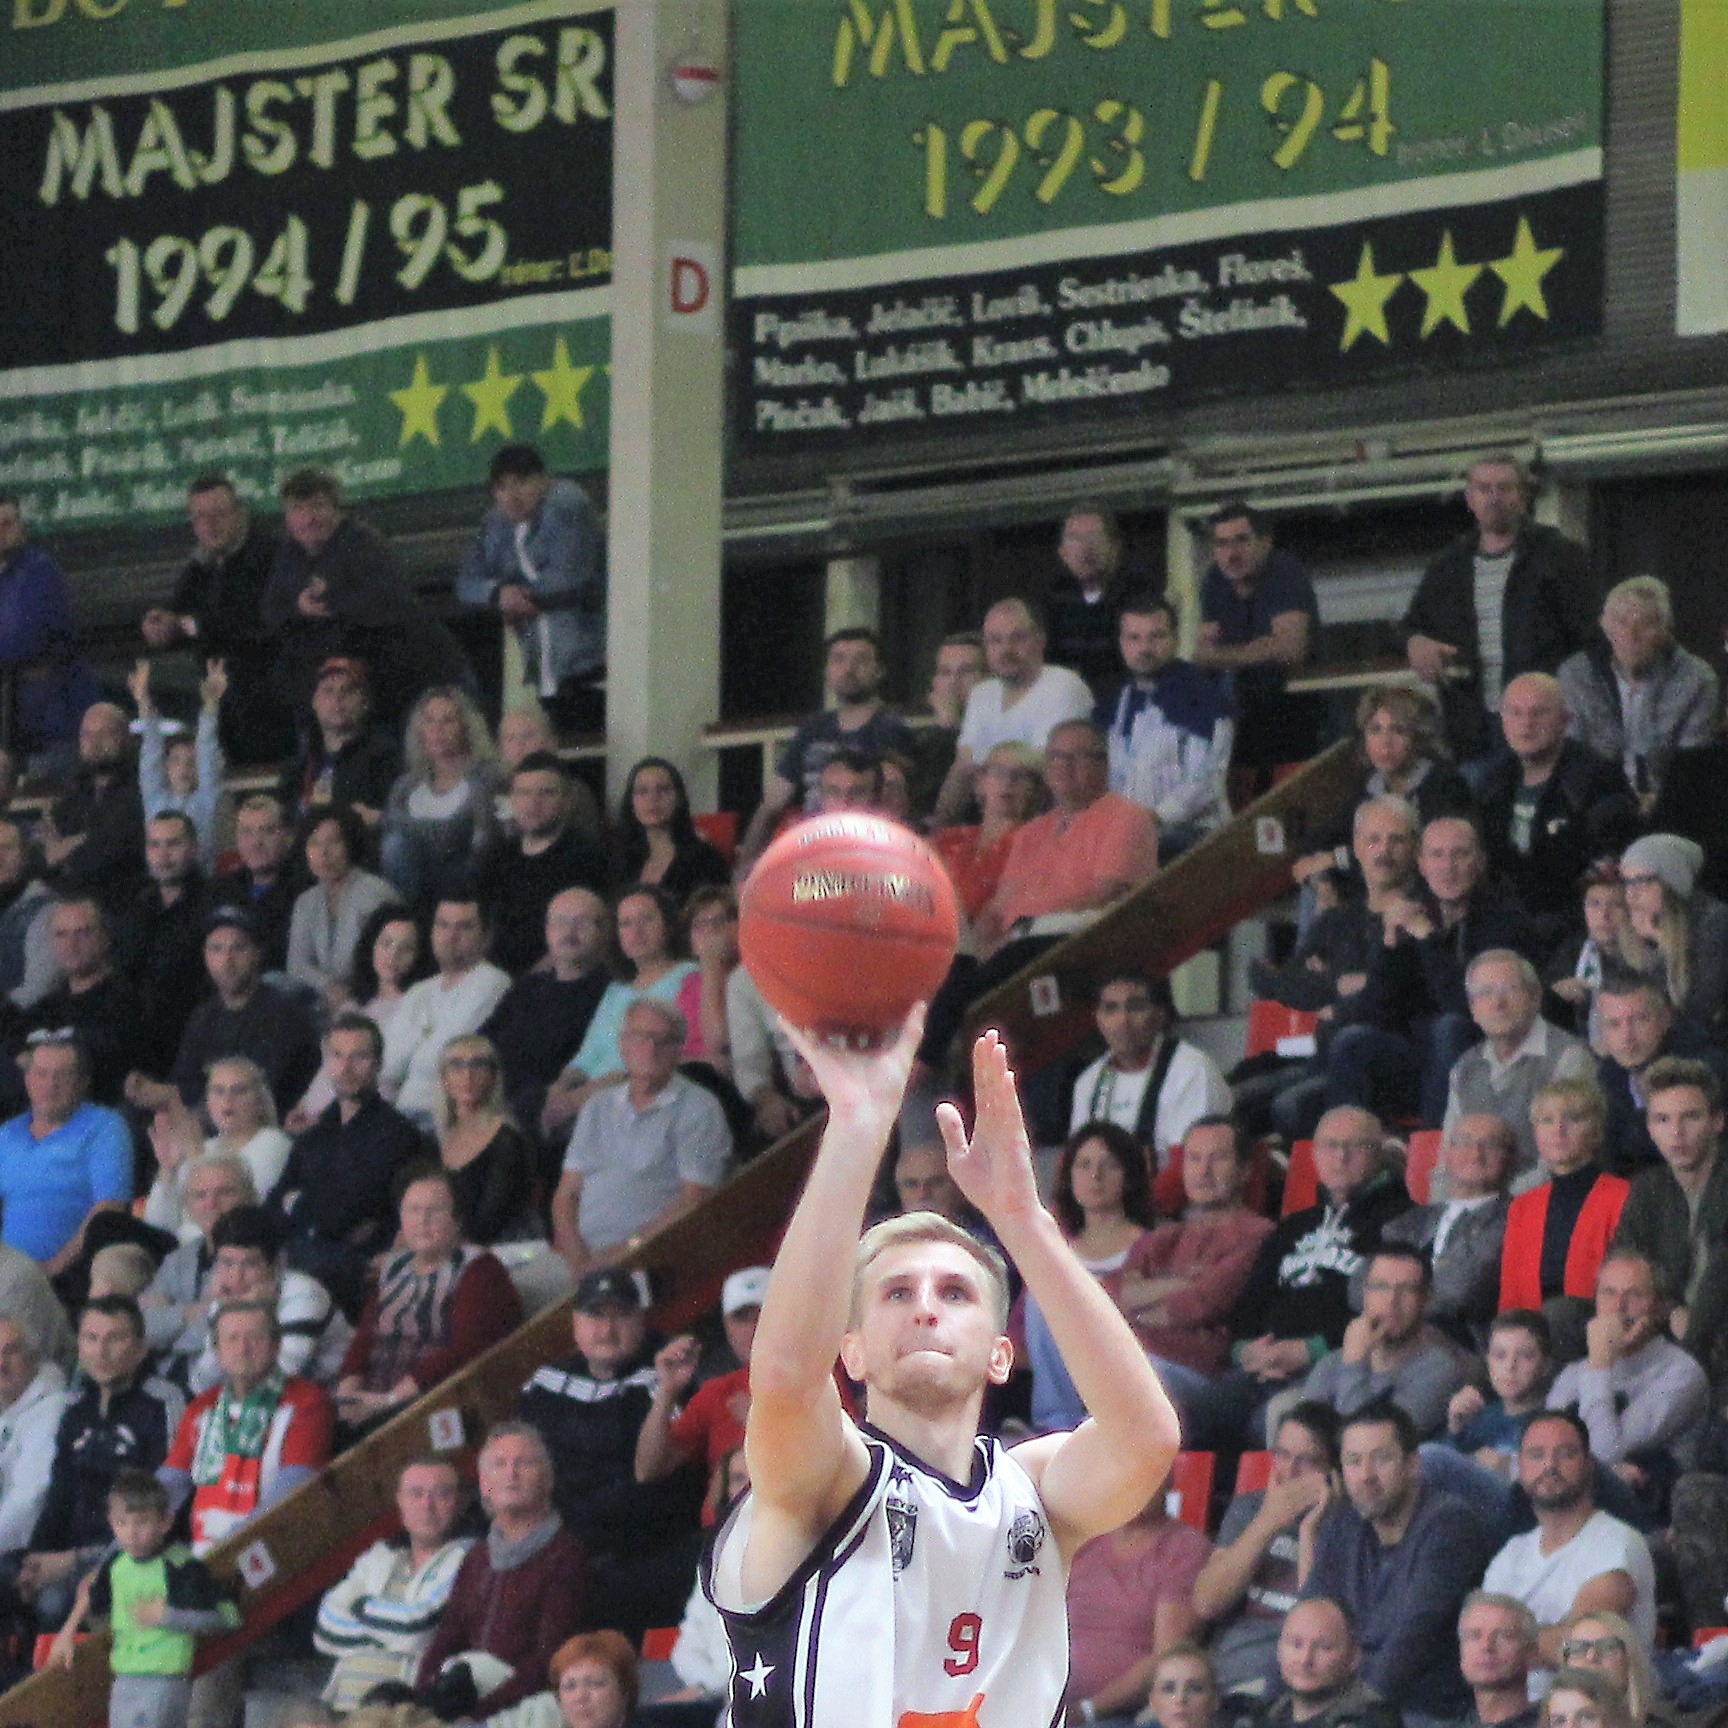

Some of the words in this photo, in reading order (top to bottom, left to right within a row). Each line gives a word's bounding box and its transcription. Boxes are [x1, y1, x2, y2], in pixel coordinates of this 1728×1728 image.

[38, 53, 461, 207] MAJSTER
[491, 26, 611, 132] SR
[912, 99, 1145, 218] 1993
[1260, 57, 1396, 169] 94
[106, 213, 314, 335] 1994
[390, 180, 508, 290] 95
[672, 256, 710, 315] D
[944, 1612, 983, 1678] 9
